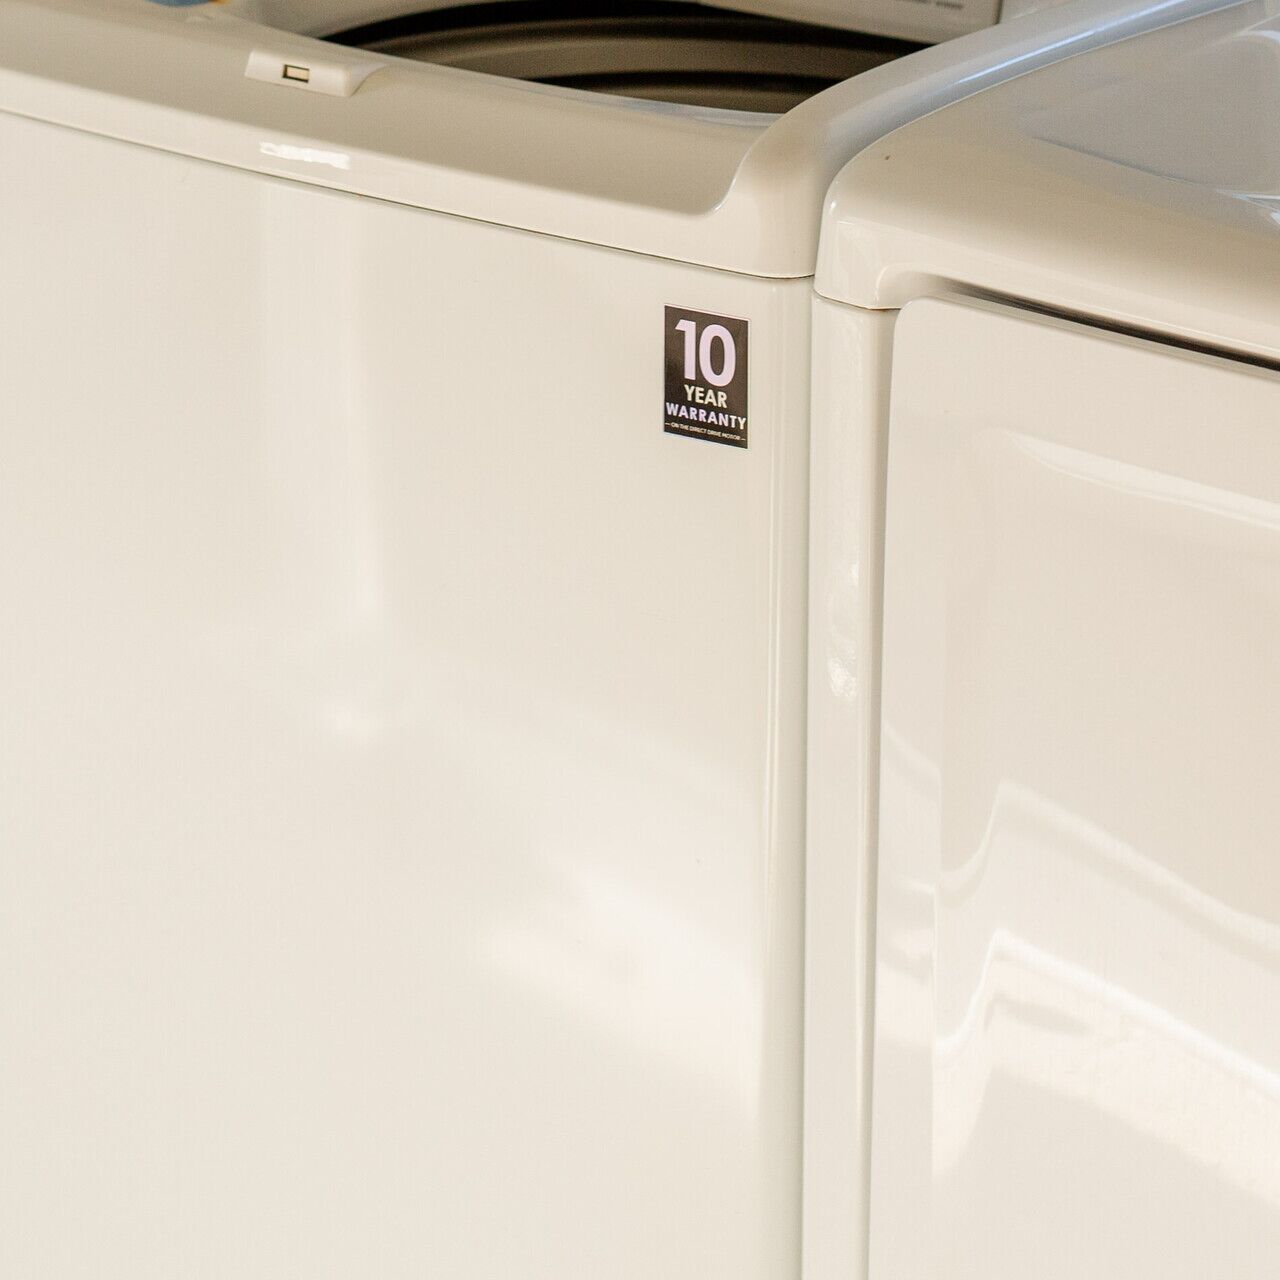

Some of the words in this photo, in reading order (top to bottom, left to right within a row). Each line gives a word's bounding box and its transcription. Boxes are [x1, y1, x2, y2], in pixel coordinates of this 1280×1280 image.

[675, 319, 736, 387] 10
[684, 384, 727, 408] YEAR
[666, 402, 746, 430] WARRANTY
